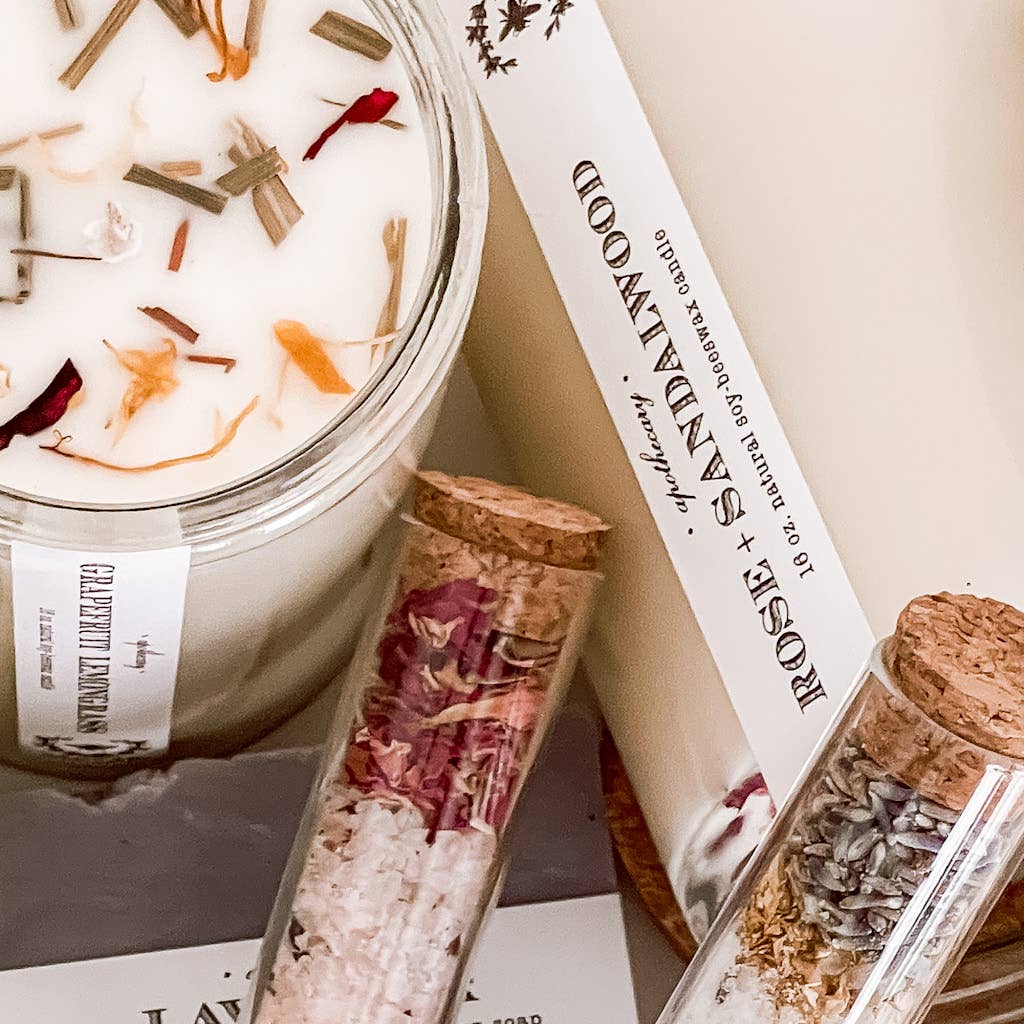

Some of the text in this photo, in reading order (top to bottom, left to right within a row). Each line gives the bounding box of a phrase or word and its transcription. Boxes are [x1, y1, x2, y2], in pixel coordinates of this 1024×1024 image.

[573, 159, 828, 715] ROSE + SANDALWOOD
[630, 392, 696, 514] apothecary
[654, 229, 814, 579] 16 oz. natural soy-beeswax candle
[78, 563, 115, 651] GRAPEFRUIT
